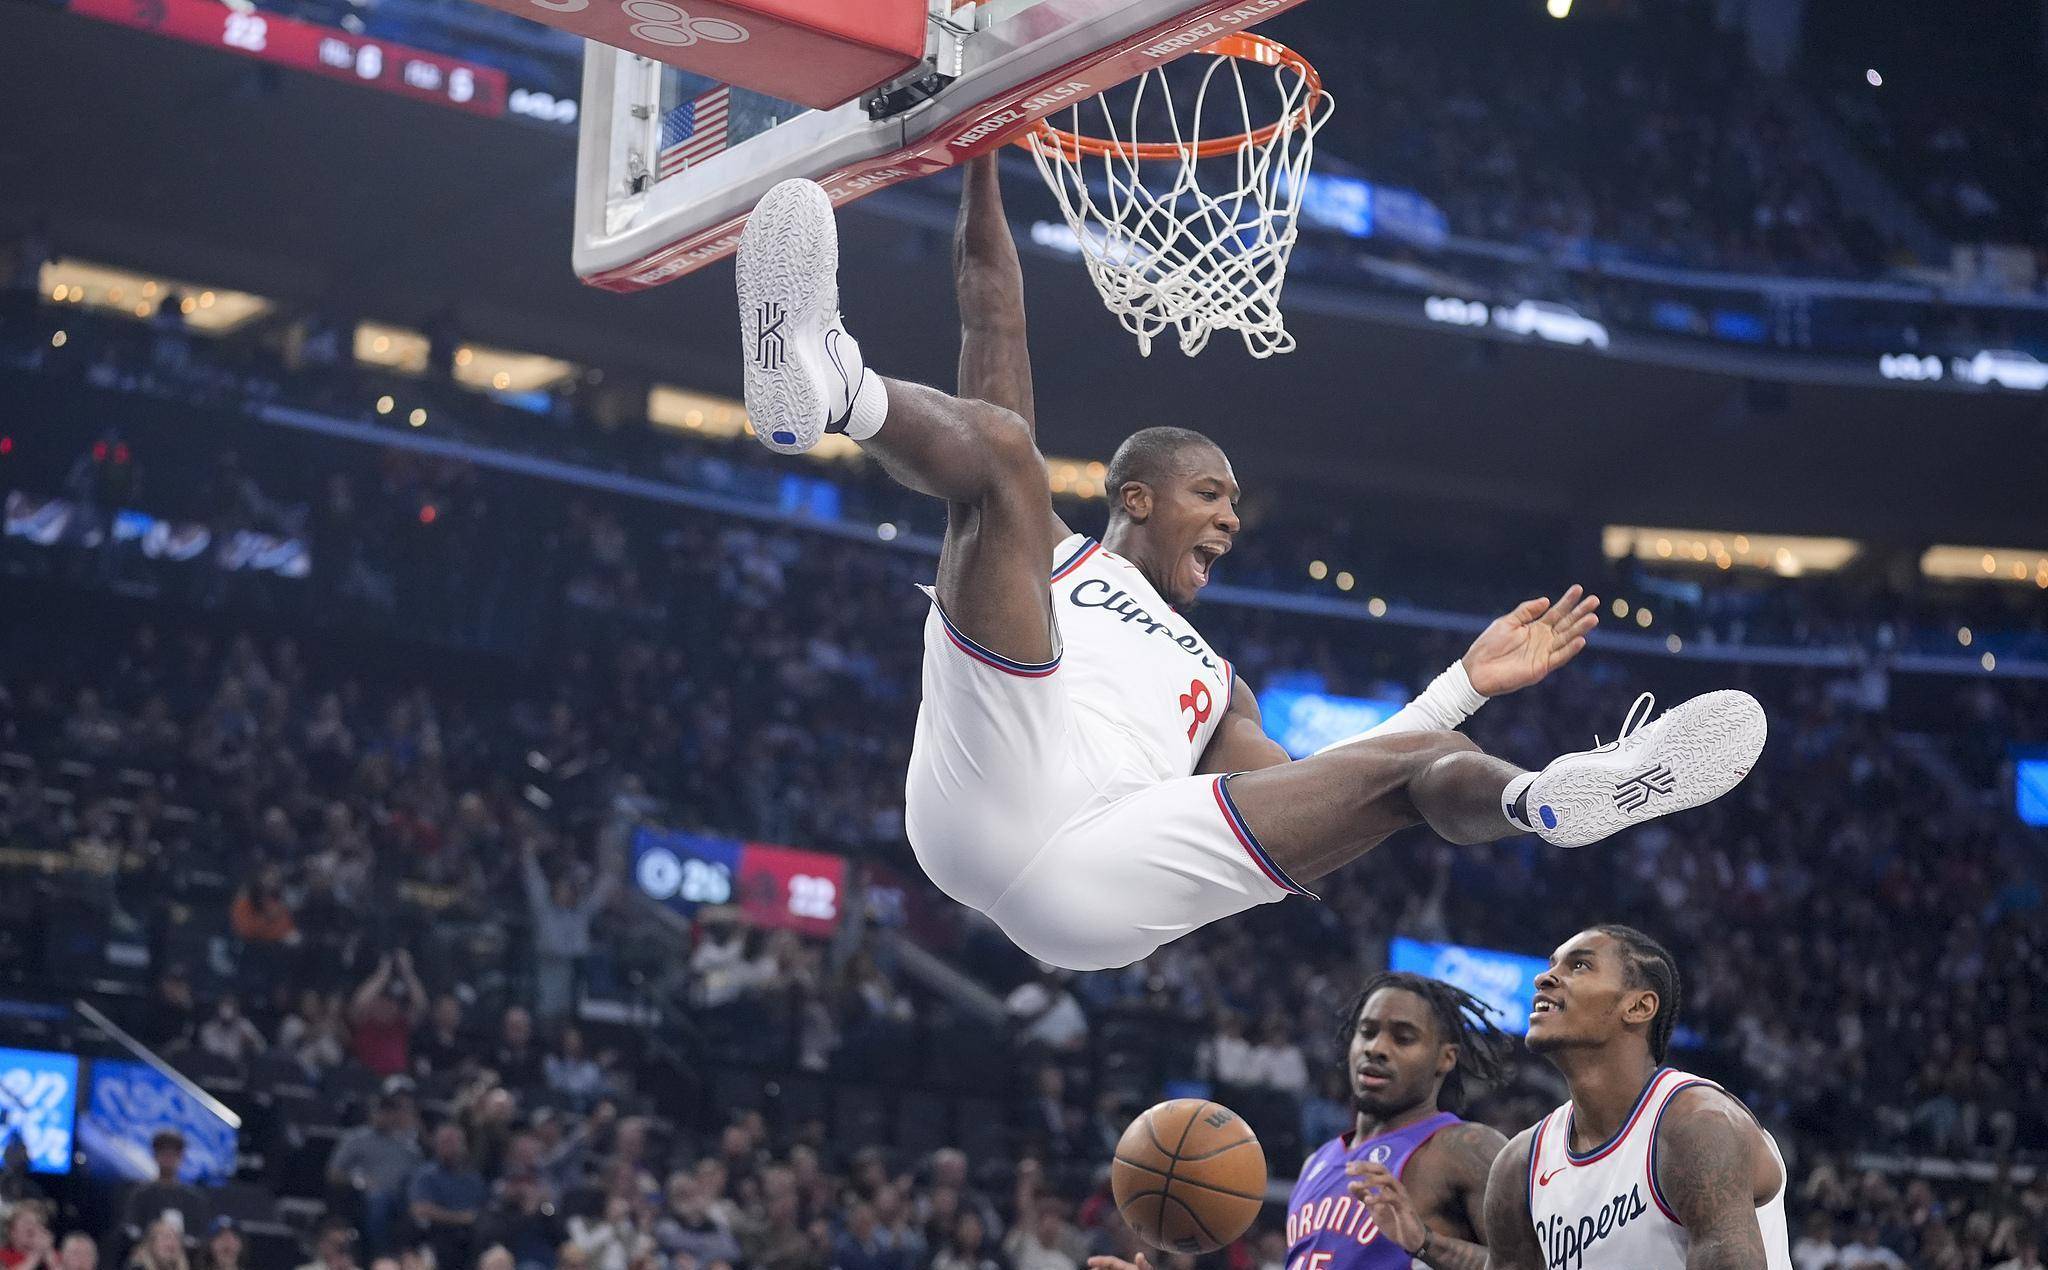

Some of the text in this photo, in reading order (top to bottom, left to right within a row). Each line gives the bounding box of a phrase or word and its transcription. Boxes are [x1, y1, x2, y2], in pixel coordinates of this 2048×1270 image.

[1142, 0, 1287, 58] HERDEZ SALS
[951, 81, 1091, 148] HERDEZ SALSA
